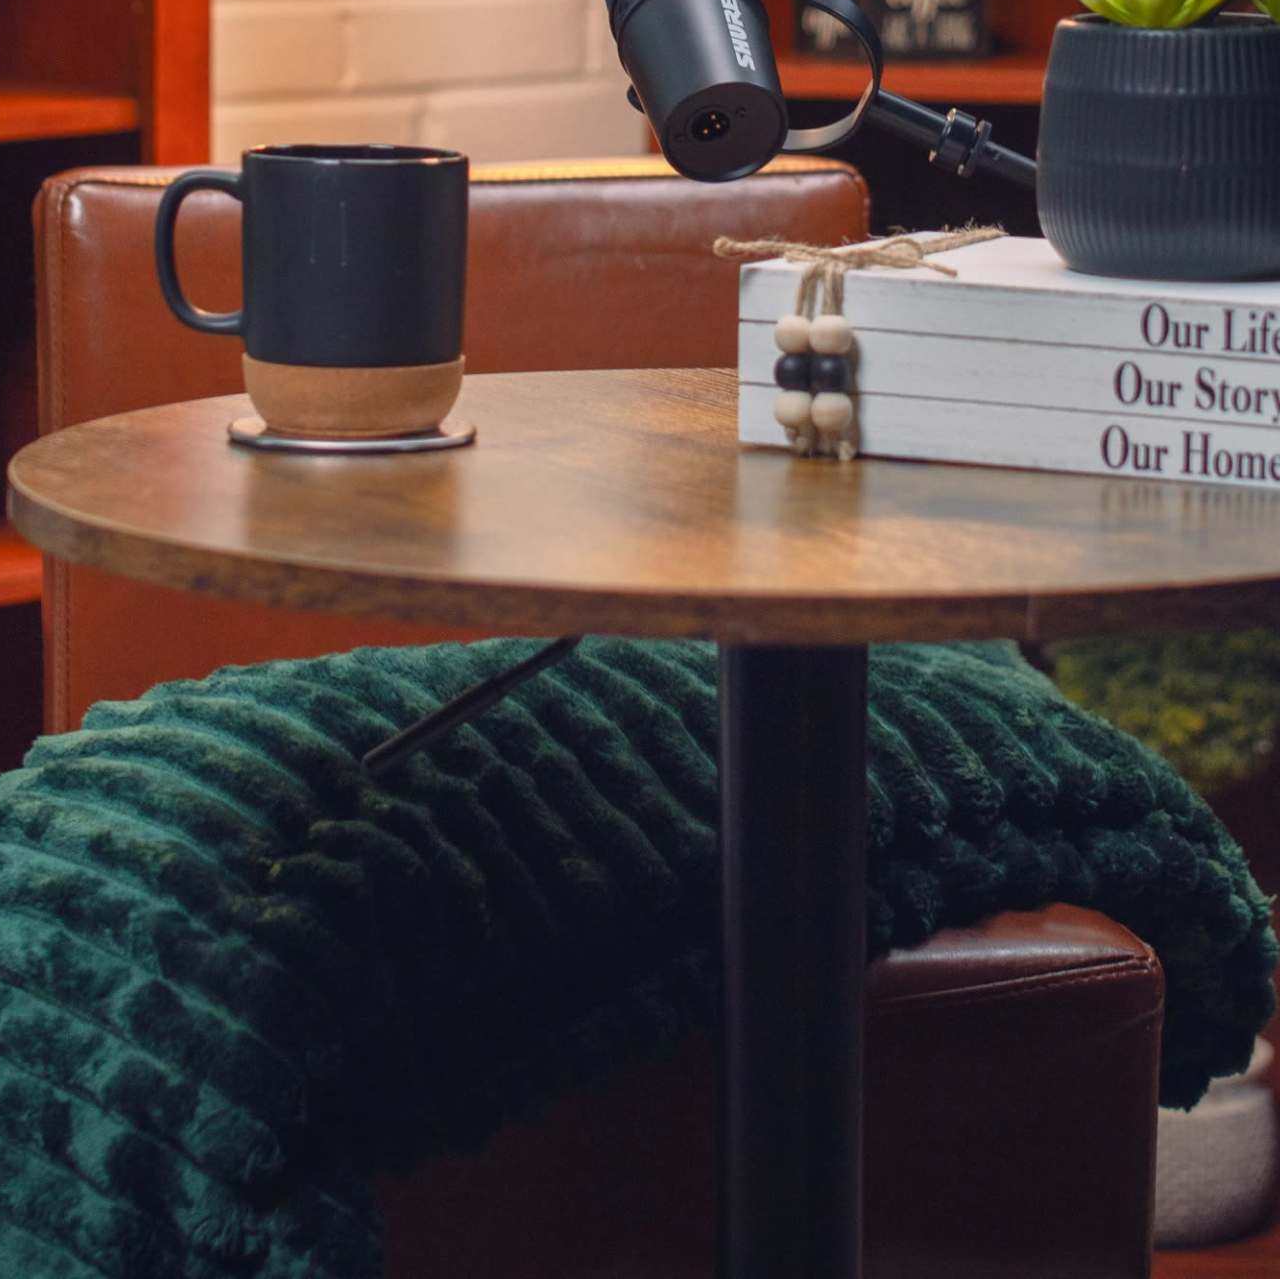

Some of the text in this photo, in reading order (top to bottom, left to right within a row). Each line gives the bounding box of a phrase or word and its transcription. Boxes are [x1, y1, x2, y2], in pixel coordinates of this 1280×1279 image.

[1140, 303, 1209, 349] Our
[1114, 361, 1182, 407] Our
[1101, 424, 1168, 471] Our
